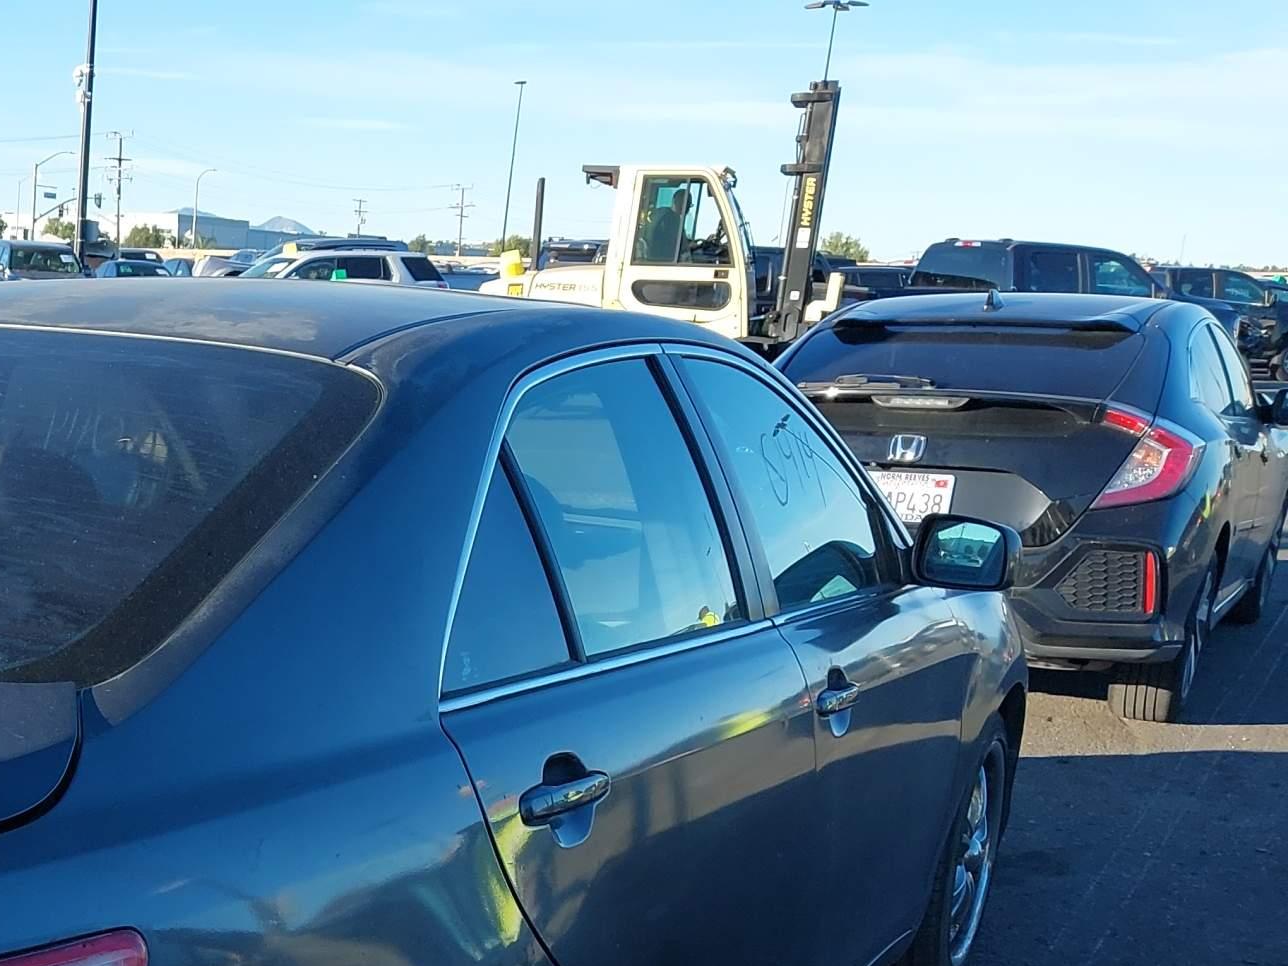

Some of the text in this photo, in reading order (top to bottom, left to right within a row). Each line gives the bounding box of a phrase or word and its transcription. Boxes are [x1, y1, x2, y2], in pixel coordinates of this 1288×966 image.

[800, 176, 817, 226] HYSTER
[535, 283, 577, 291] HYSTER
[904, 473, 930, 482] REEVES
